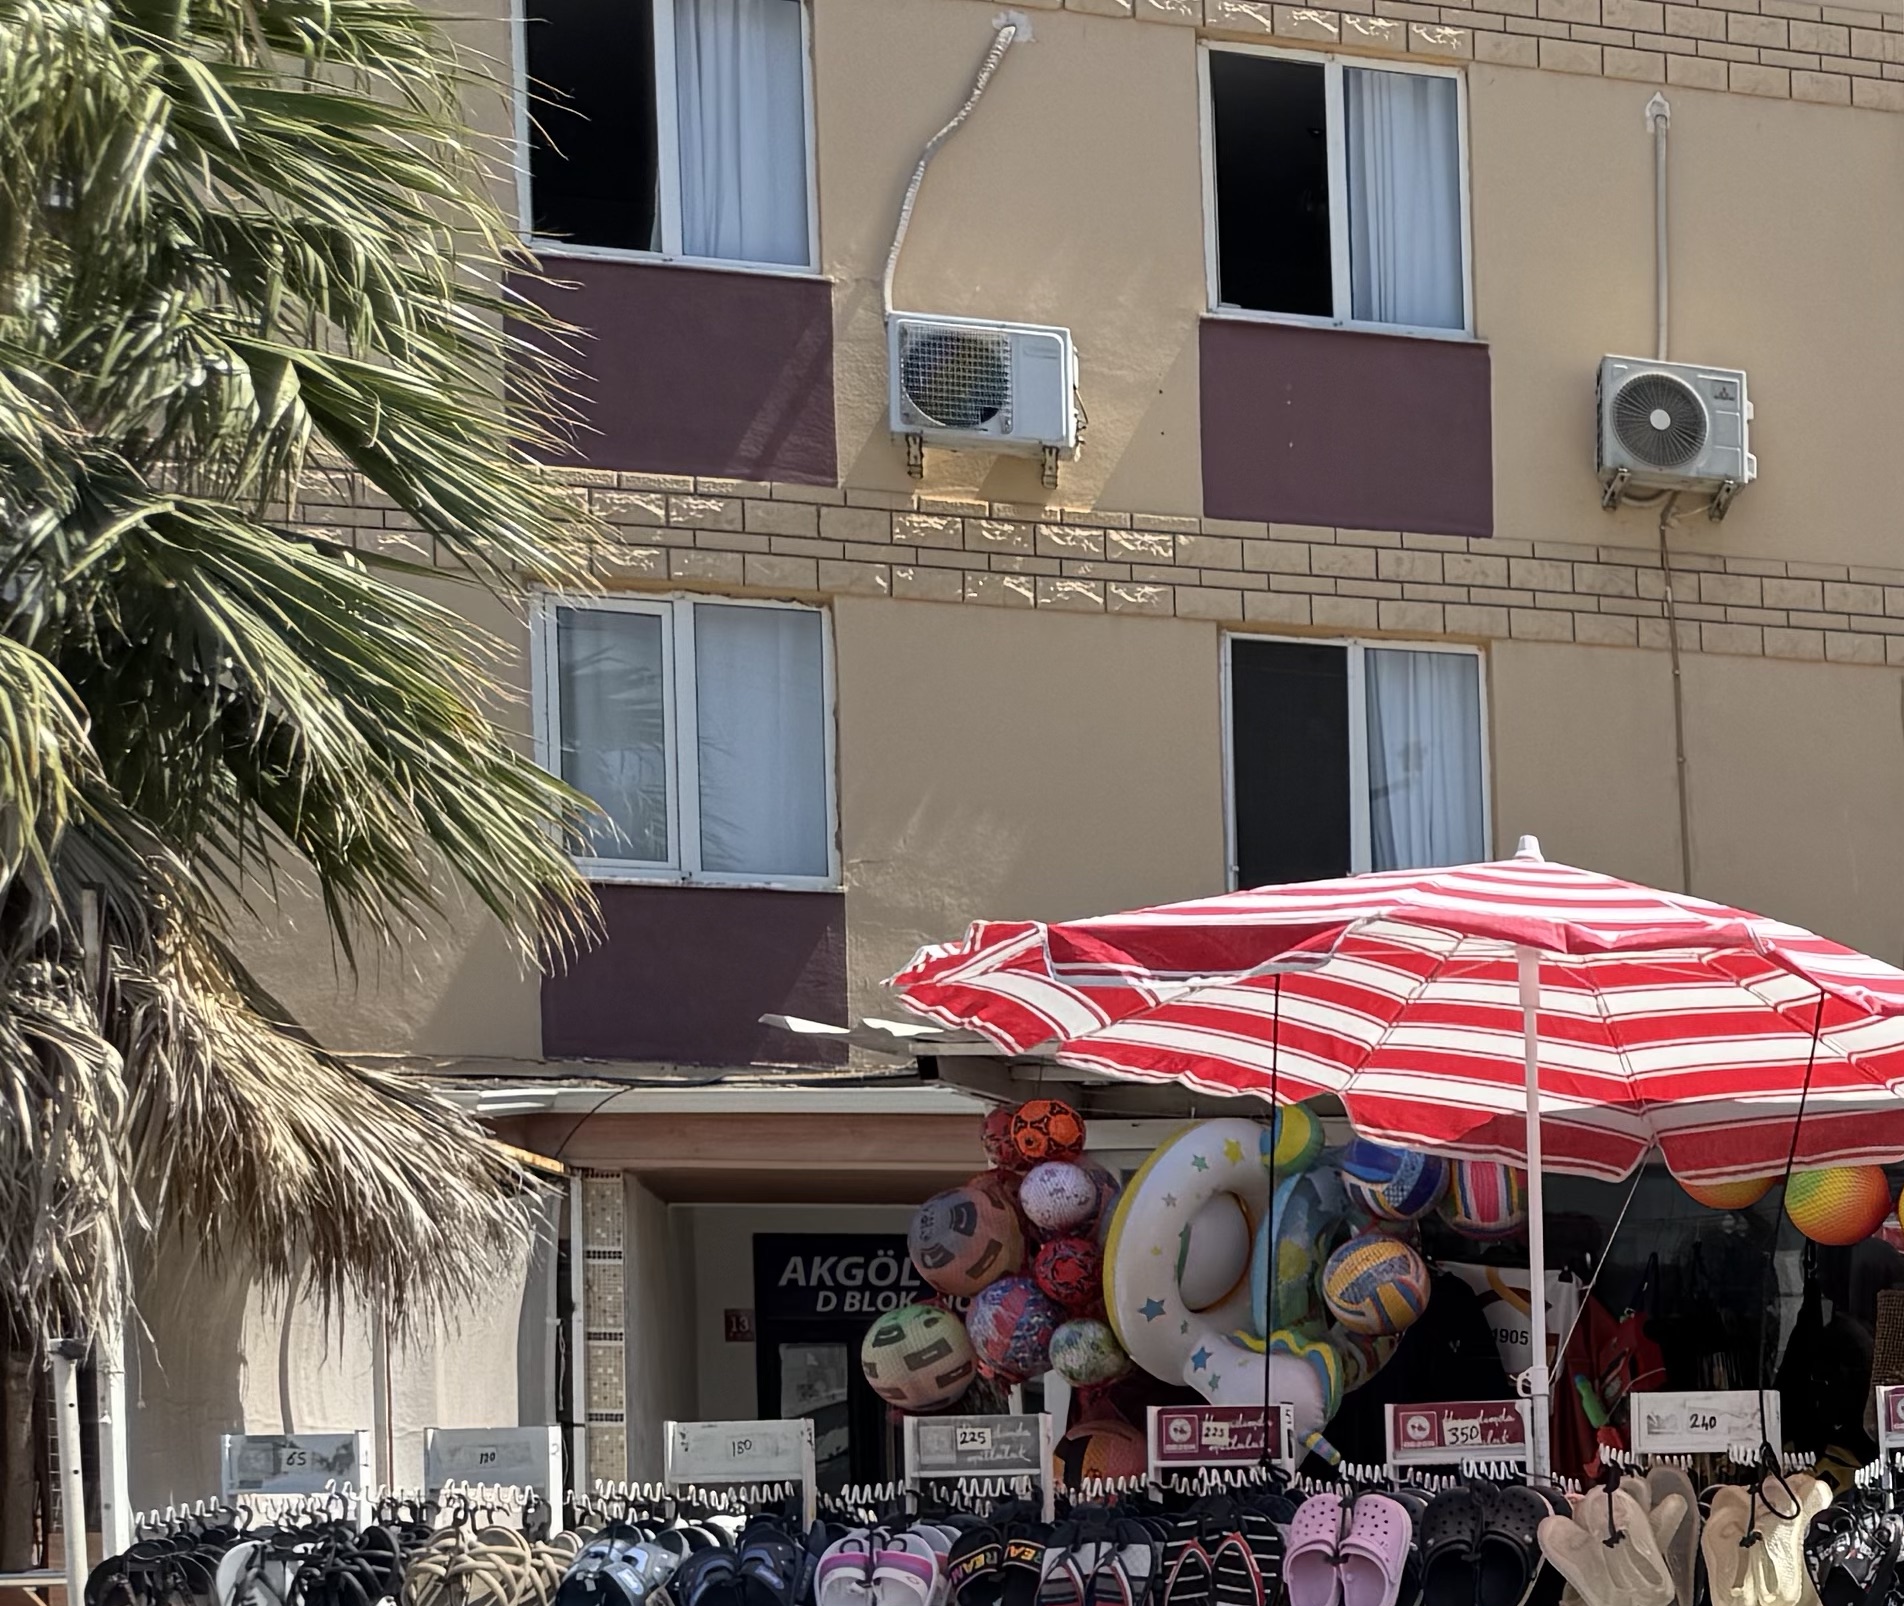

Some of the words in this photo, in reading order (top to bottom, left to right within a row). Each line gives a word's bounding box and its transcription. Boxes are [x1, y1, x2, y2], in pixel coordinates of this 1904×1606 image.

[777, 1249, 921, 1287] AKGÖL
[816, 1291, 838, 1312] D
[843, 1291, 918, 1312] BLOK
[730, 1316, 750, 1332] 13
[1689, 1413, 1718, 1432] 240
[959, 1430, 987, 1446] 225
[1447, 1424, 1480, 1446] 350
[285, 1450, 308, 1466] 65
[951, 1551, 998, 1583] REAM
